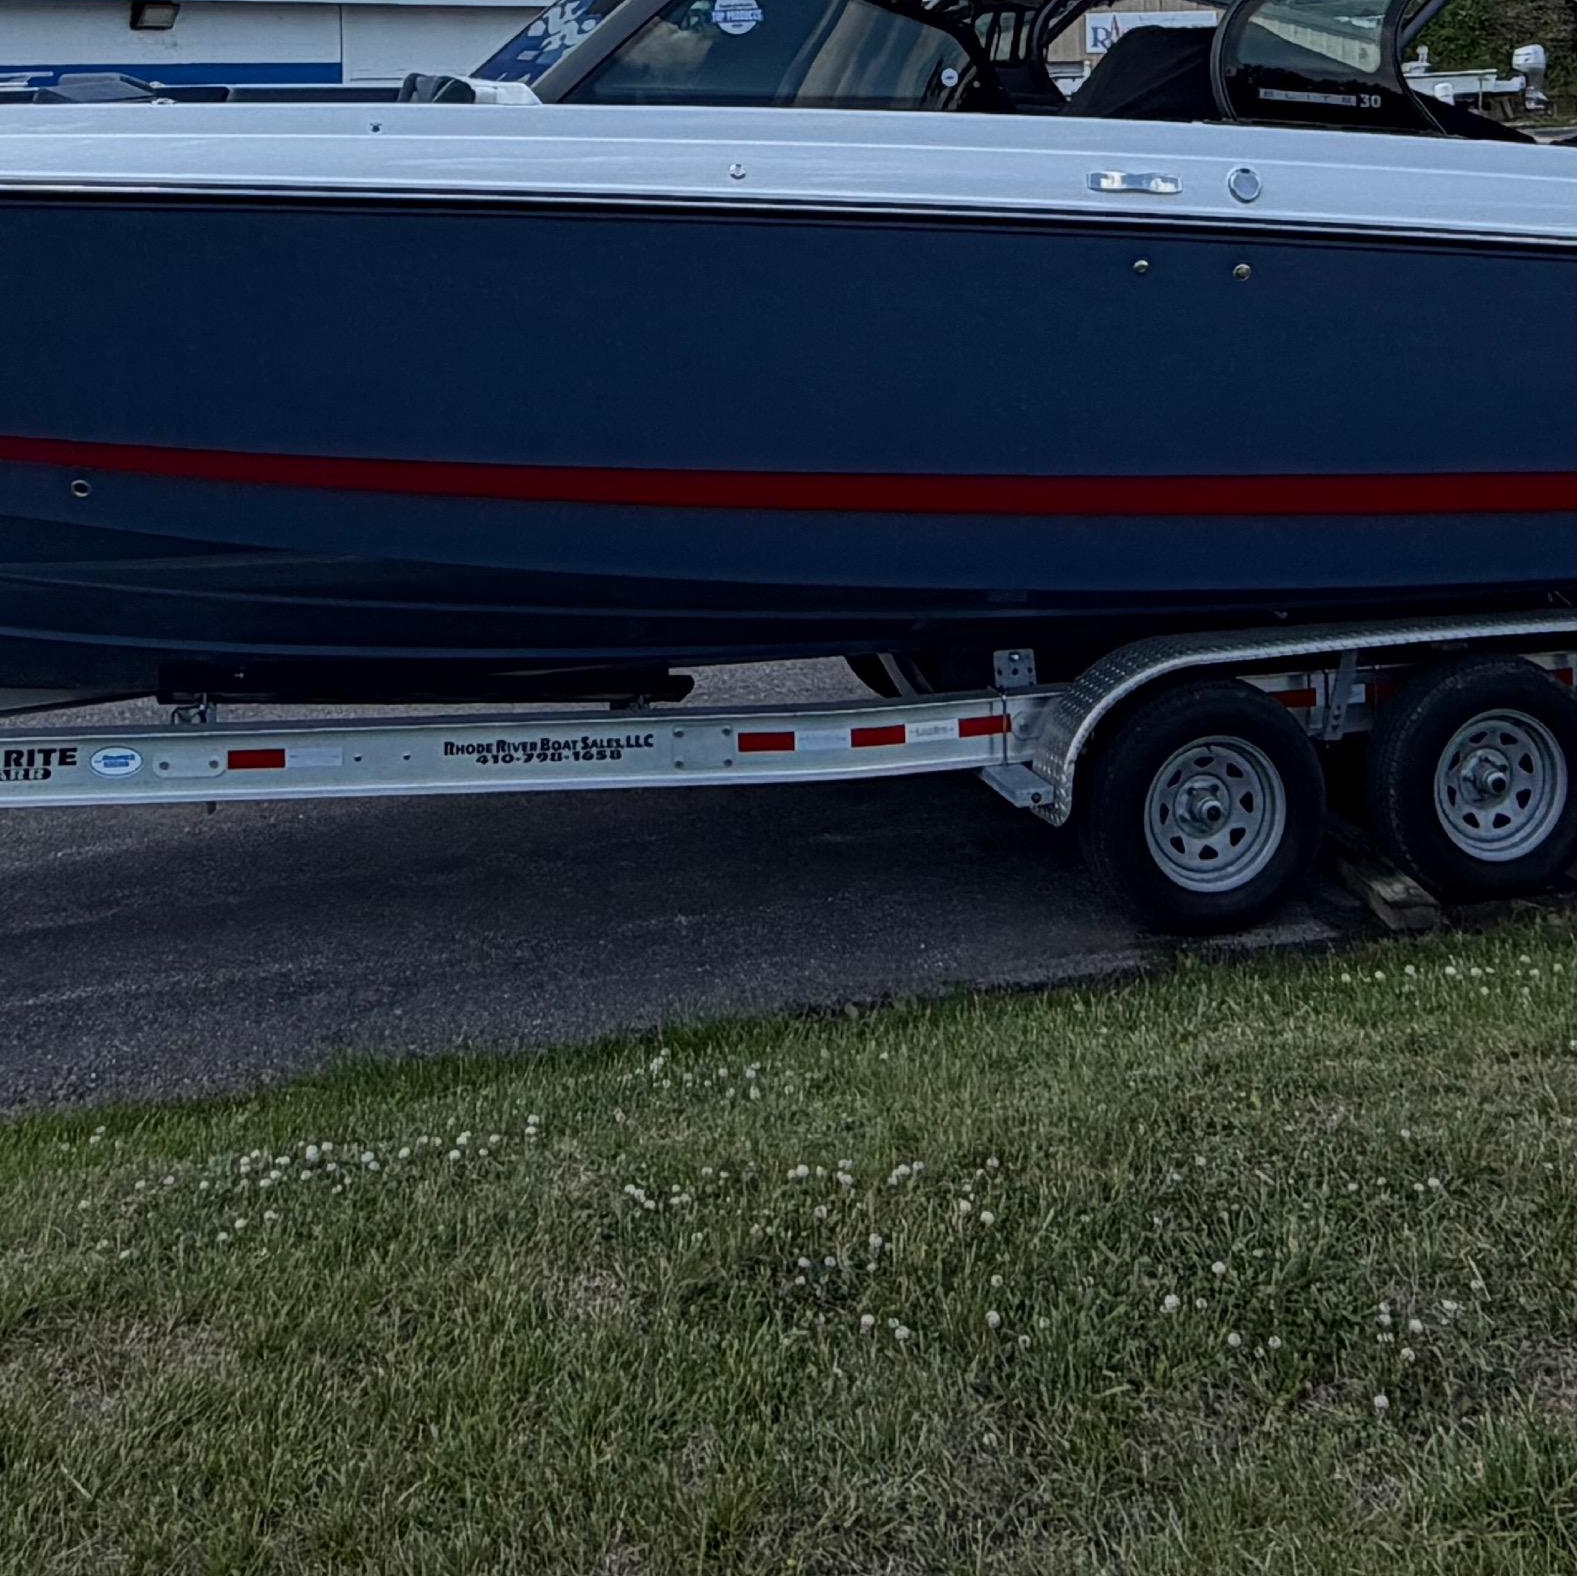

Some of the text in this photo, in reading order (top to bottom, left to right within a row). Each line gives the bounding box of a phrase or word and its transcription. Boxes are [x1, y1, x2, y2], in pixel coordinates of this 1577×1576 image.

[1359, 93, 1382, 108] 30
[540, 737, 579, 752] BOAT
[626, 733, 654, 748] LLC
[4, 748, 78, 768] RITE
[475, 749, 622, 765] 410-798-1658
